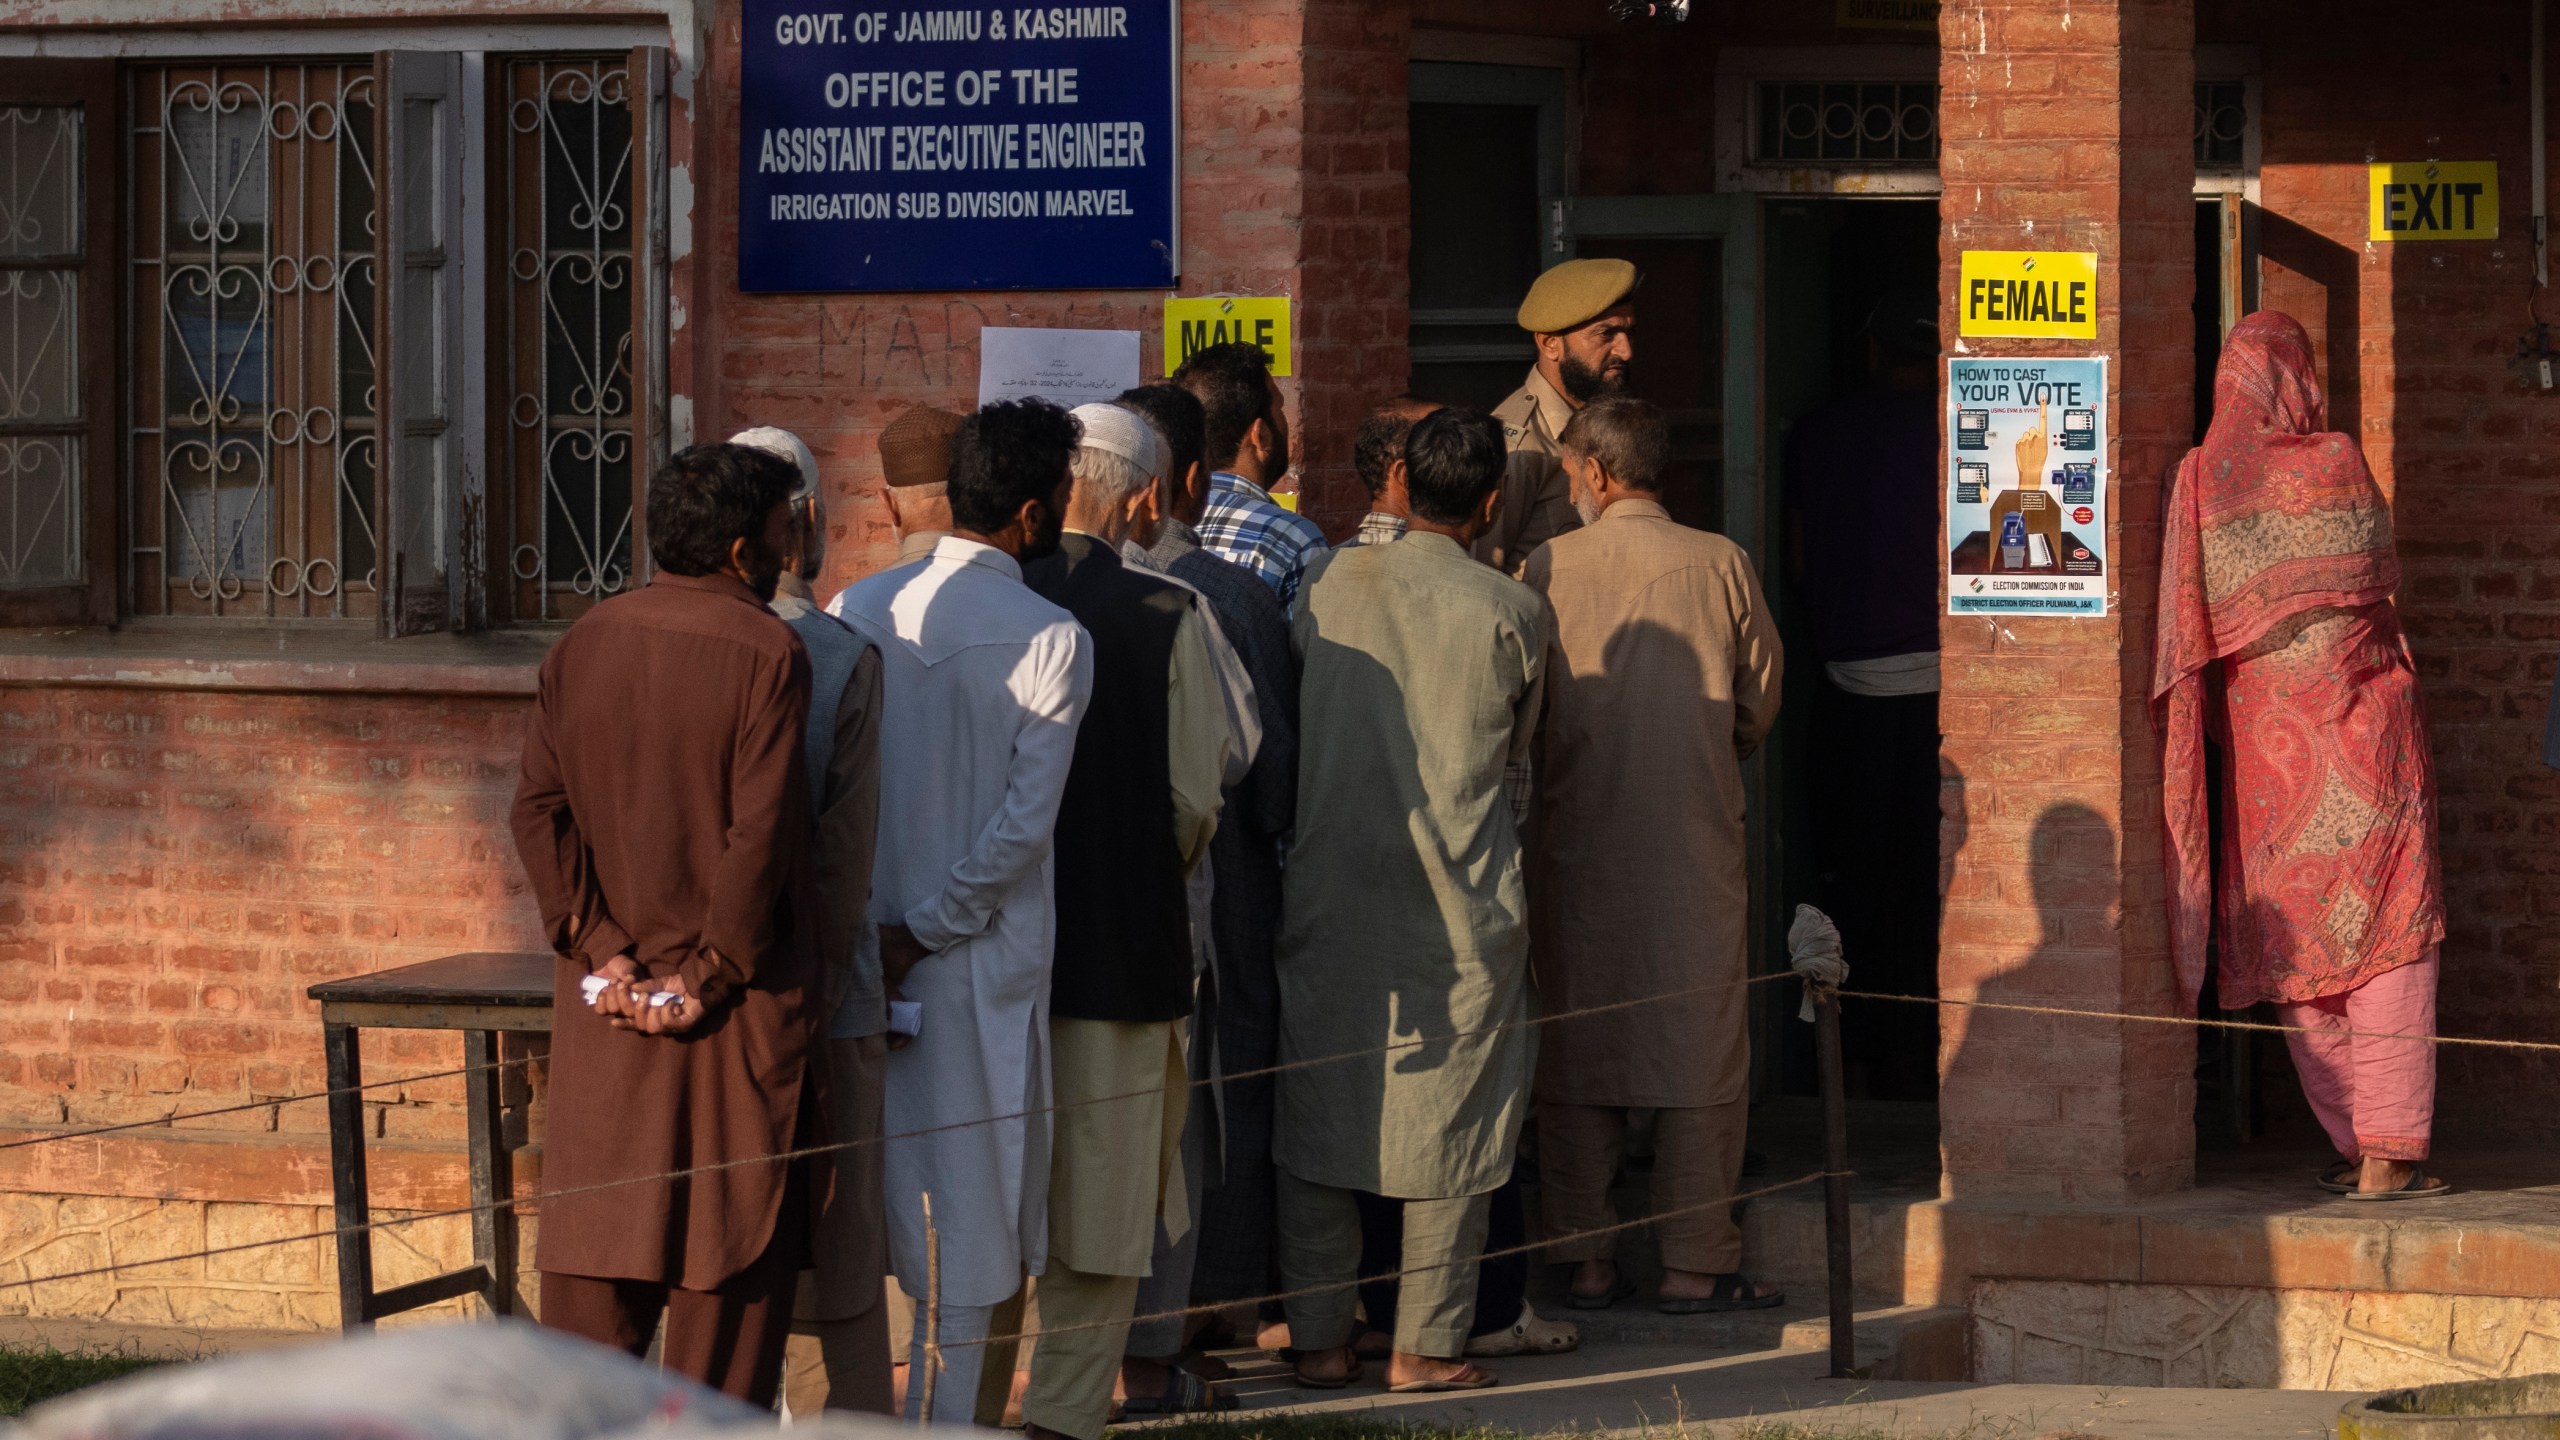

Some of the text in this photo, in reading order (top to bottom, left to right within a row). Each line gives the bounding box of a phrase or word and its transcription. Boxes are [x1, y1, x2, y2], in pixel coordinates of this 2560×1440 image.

[1848, 0, 1939, 21] SURVEILLANC
[776, 7, 1128, 44] GOVT. OF JAMMU & KASHMIR
[825, 68, 1078, 107] OFFICE OF THE
[759, 122, 1146, 173] ASSISTANT EXECUTIVE ENGINEER
[771, 190, 1133, 220] IRRIGATION SUB DIVISION MARVEL
[2383, 183, 2483, 230] EXIT
[1970, 279, 2086, 322] FEMALE
[1958, 369, 2046, 381] HOW TO CAST
[1959, 382, 2081, 406] YOUR VOTE
[1504, 426, 1518, 438] KP
[1993, 582, 2084, 590] ELECTION COMMISSION OF INDIA
[1961, 599, 1988, 607] DISTRICT
[2046, 600, 2079, 609] PULWAMA,
[2080, 600, 2093, 608] J&K
